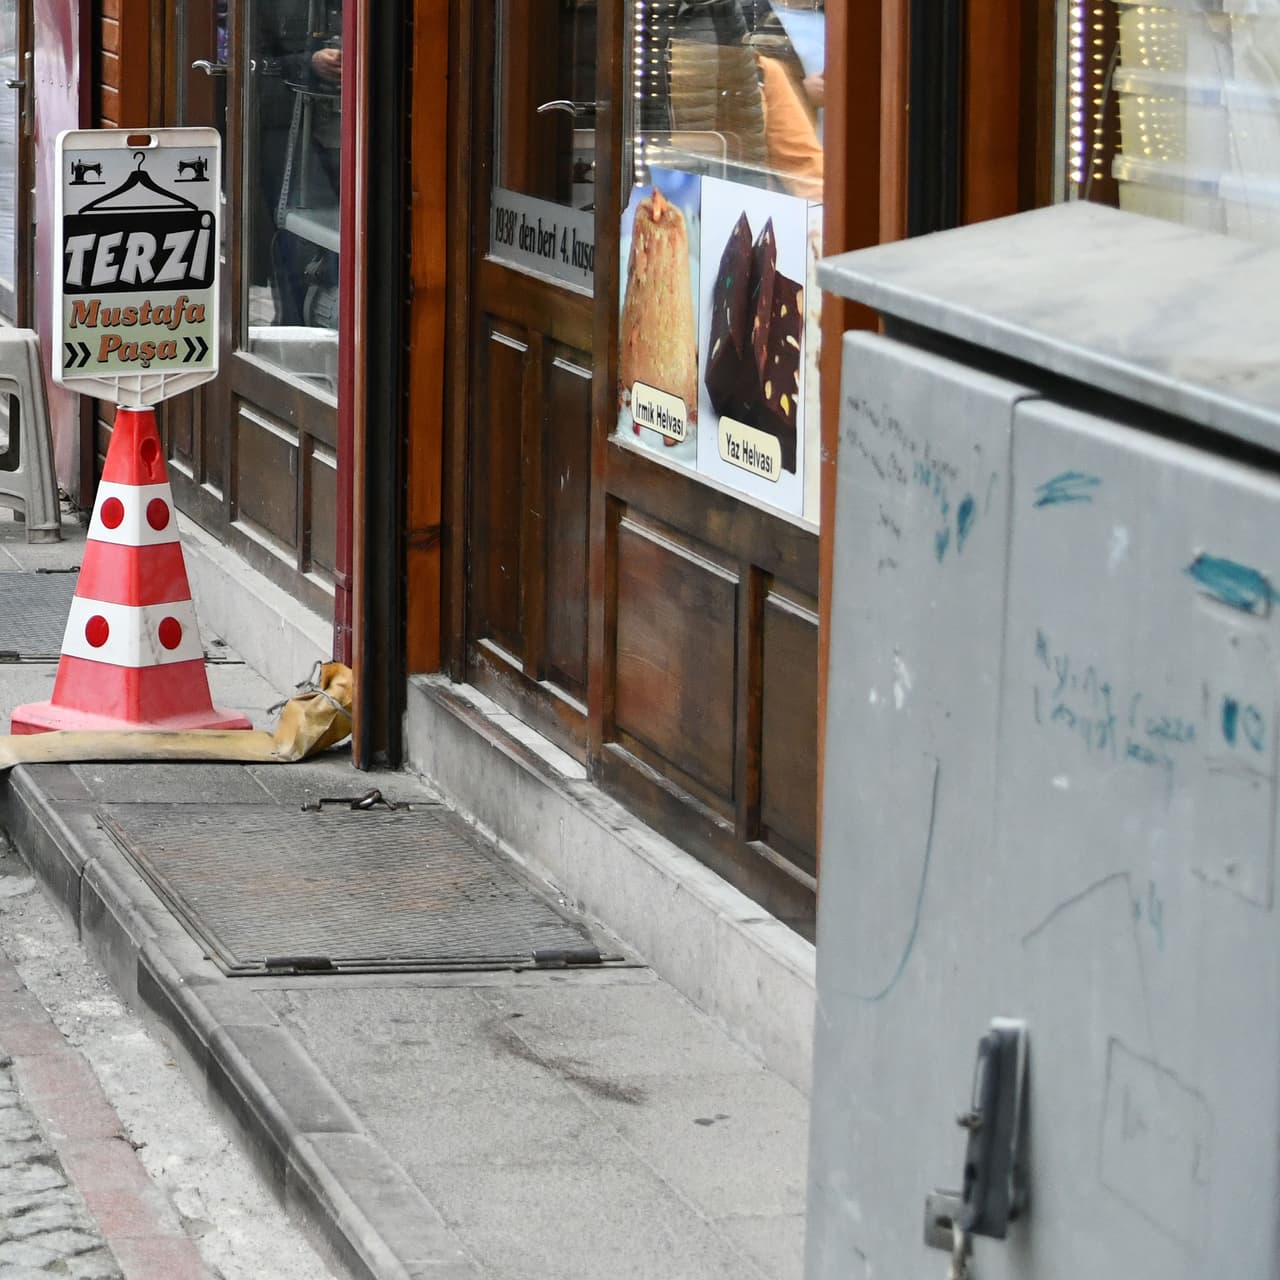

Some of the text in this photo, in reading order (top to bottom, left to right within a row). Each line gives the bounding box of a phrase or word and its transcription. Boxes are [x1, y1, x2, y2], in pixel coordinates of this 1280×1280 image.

[65, 213, 211, 286] TERZİ
[519, 213, 535, 253] den
[537, 217, 556, 260] beri
[69, 295, 206, 331] Mustafa
[97, 334, 178, 368] Paşa
[726, 432, 773, 474] Yaz Helvası
